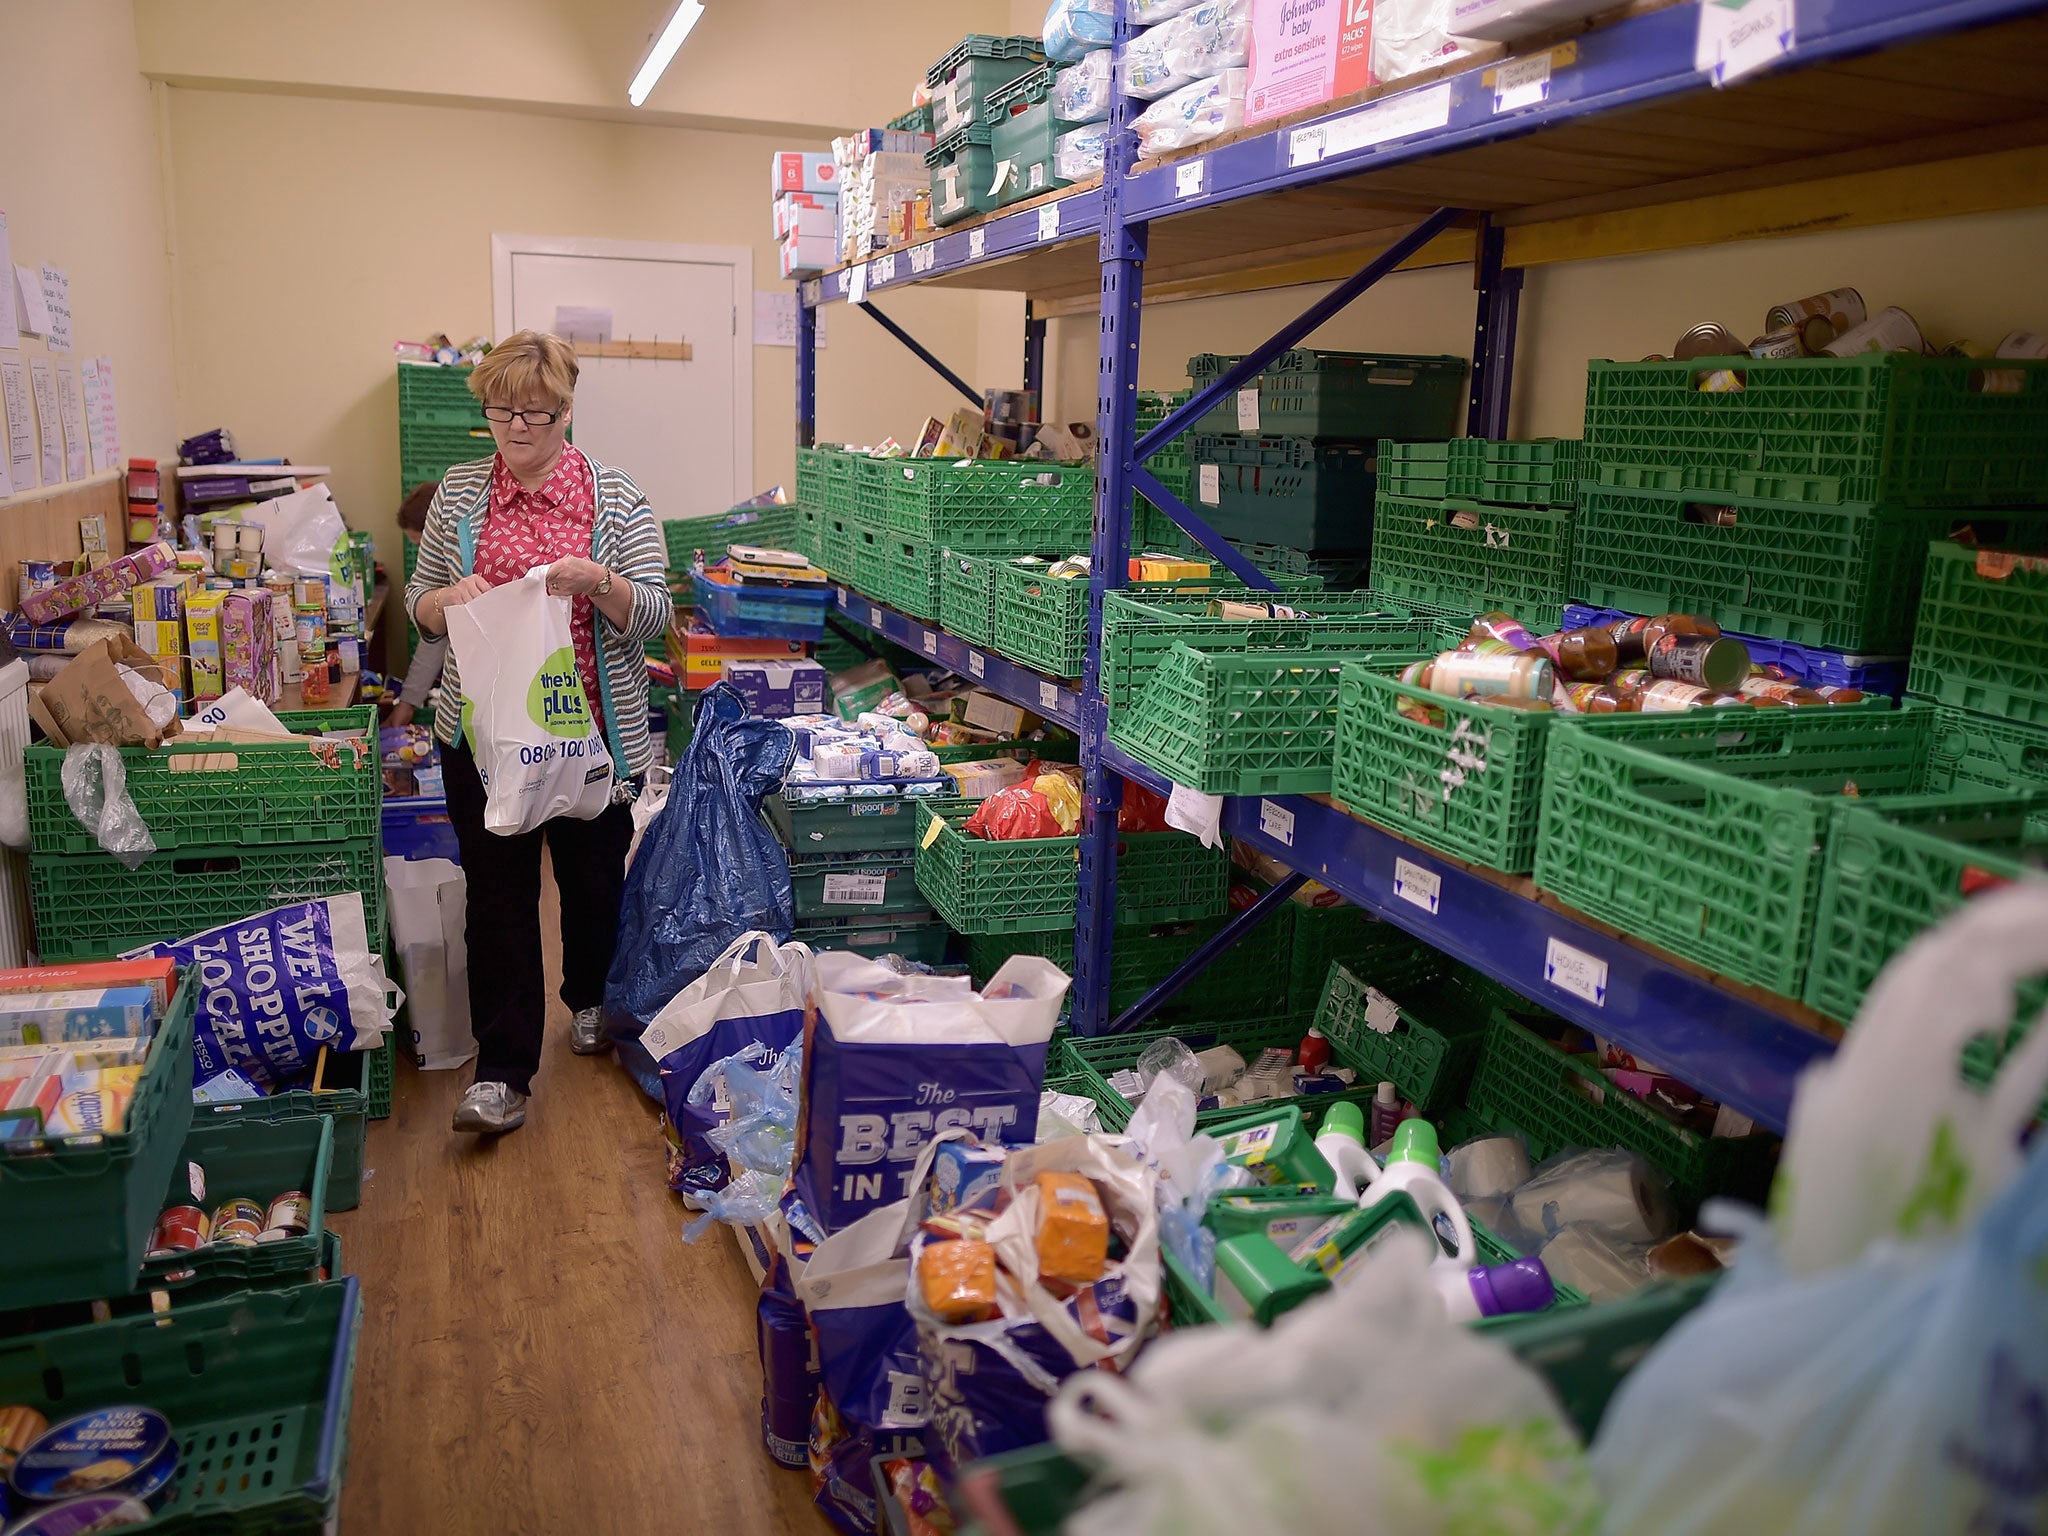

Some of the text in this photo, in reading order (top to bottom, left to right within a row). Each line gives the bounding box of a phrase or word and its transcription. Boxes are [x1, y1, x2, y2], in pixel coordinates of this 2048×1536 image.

[1345, 0, 1370, 26] 12
[1291, 19, 1312, 36] baby
[1274, 48, 1293, 62] extra
[1293, 34, 1327, 57] sensitive
[787, 168, 796, 179] 6
[544, 690, 582, 722] plus
[559, 740, 585, 758] 100
[193, 937, 252, 1066] LOCAL
[193, 1034, 214, 1070] TESCO
[916, 1081, 957, 1106] The
[836, 1105, 1018, 1167] BEST
[842, 1172, 883, 1201] IN
